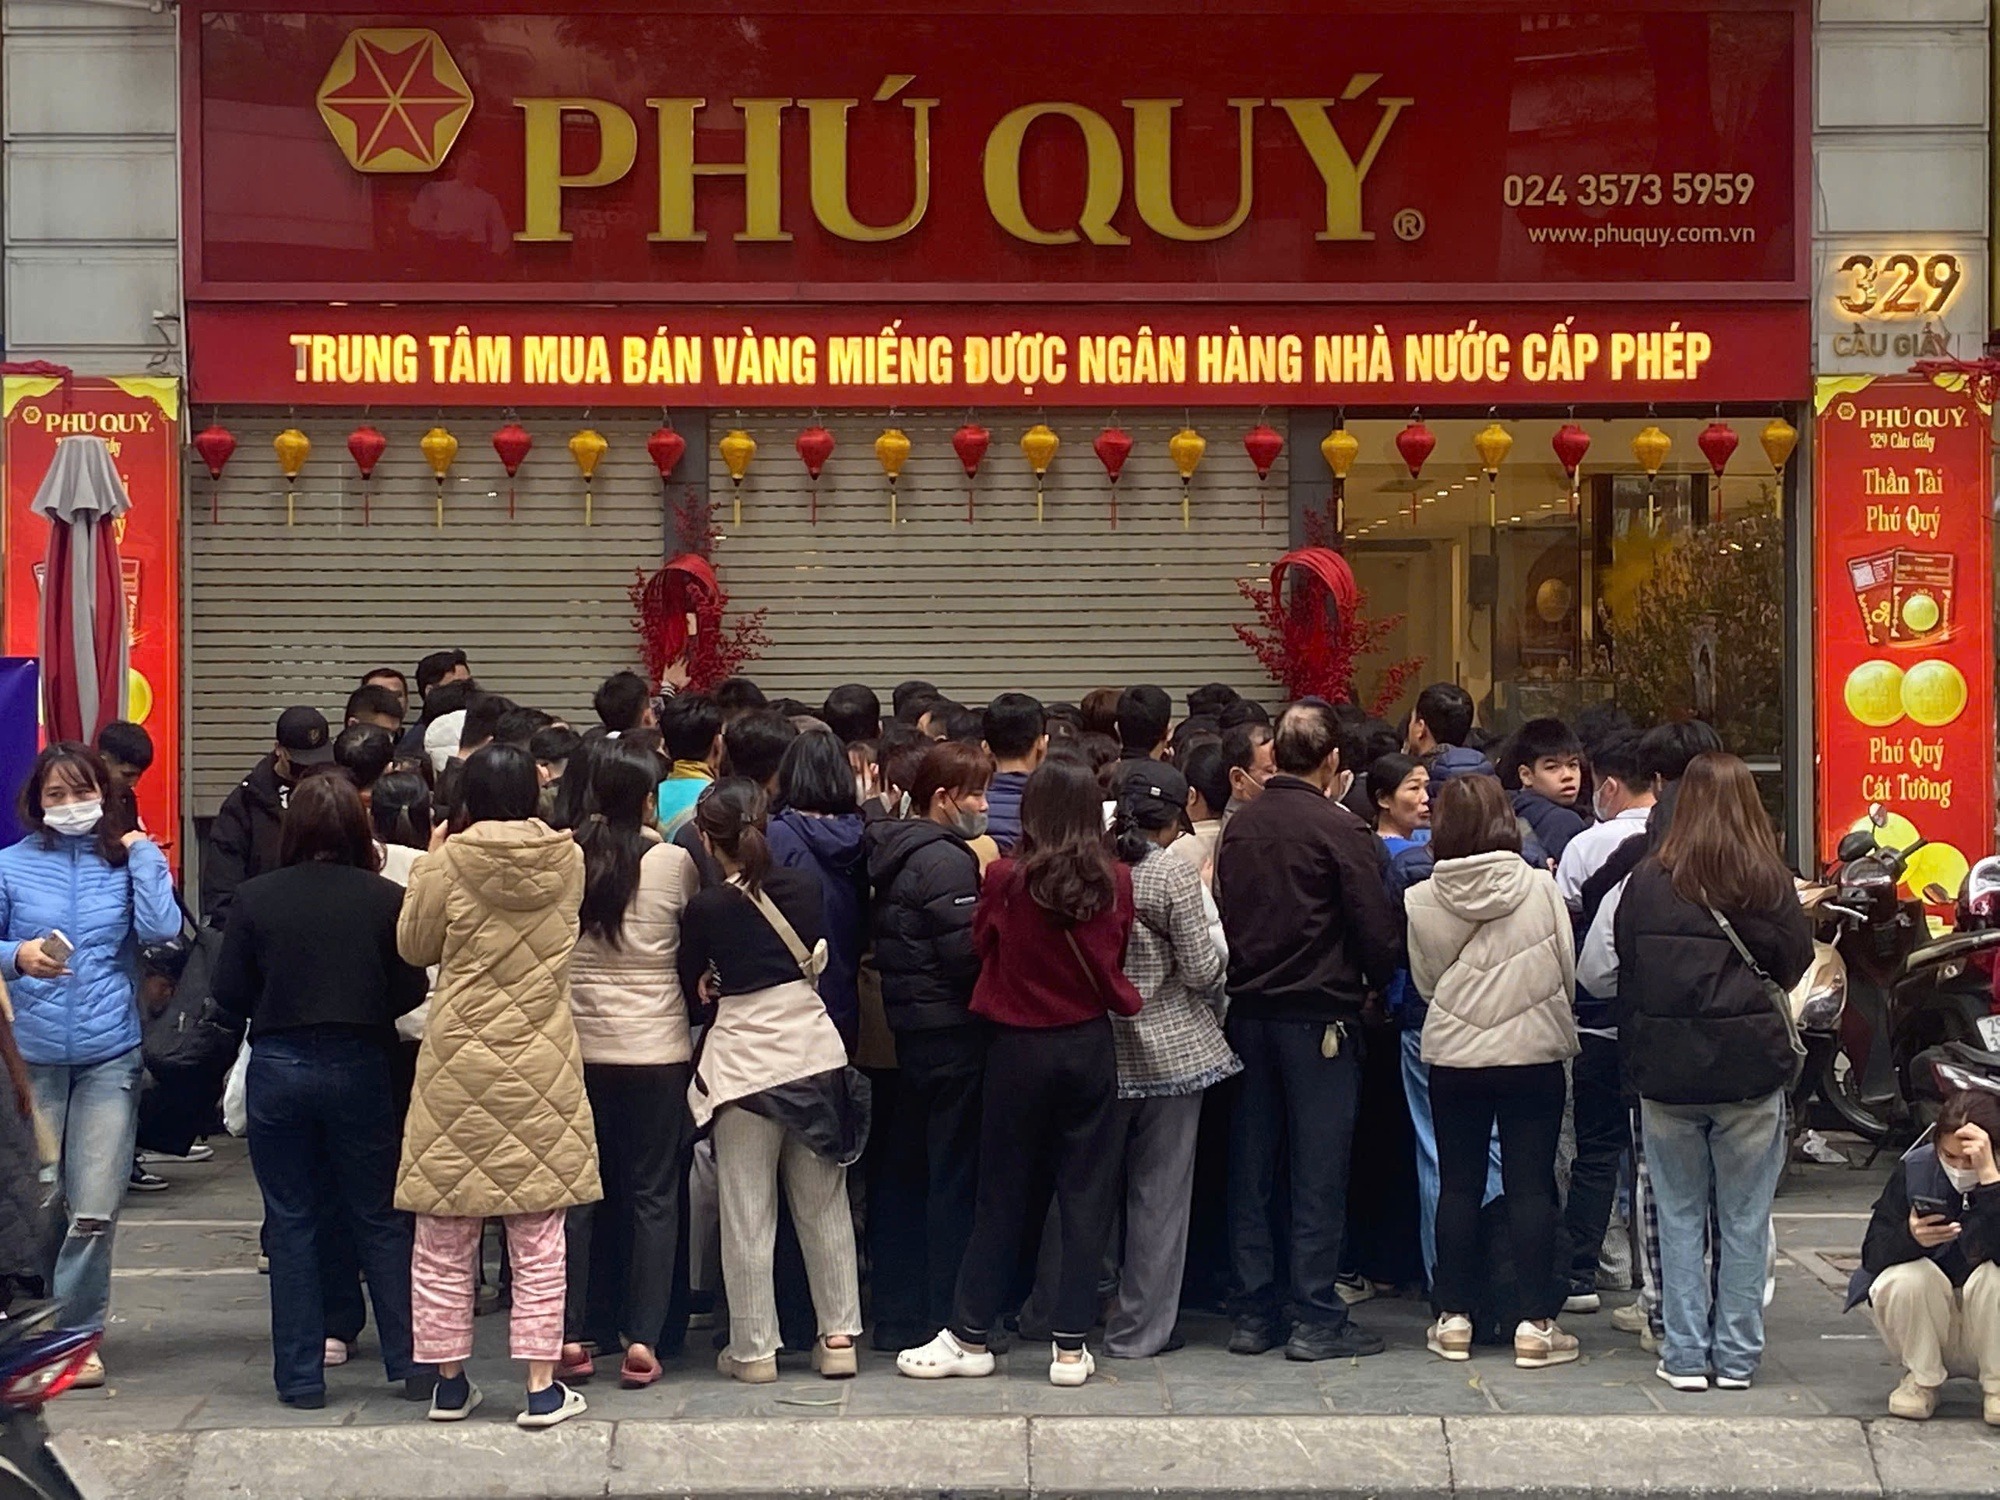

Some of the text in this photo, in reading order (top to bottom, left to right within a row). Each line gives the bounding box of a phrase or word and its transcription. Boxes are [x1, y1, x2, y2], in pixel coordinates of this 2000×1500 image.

[513, 74, 940, 242] PHÚ
[983, 73, 1415, 245] QUÝ
[1503, 172, 1755, 206] 024 3573 5959
[1527, 221, 1756, 248] www.phuquy.com.vn
[1836, 254, 1961, 314] 329
[289, 315, 1713, 396] TRUNG TÂM MUA BÁN VÀNG MIẾNG ĐƯỢC NGÂN HÀNG NHÀ NƯỚC CẤP PHÉP
[1833, 321, 1888, 357] CẦU
[45, 411, 152, 433] PHÚ QUÝ
[1860, 405, 1967, 429] PHÚ QUÝ
[1869, 432, 1888, 449] 329
[1862, 466, 1944, 495] Thần Tài
[1866, 504, 1941, 539] Phú Quý
[1869, 736, 1944, 771] Phú Quý
[1862, 773, 1952, 809] Cát Tường
